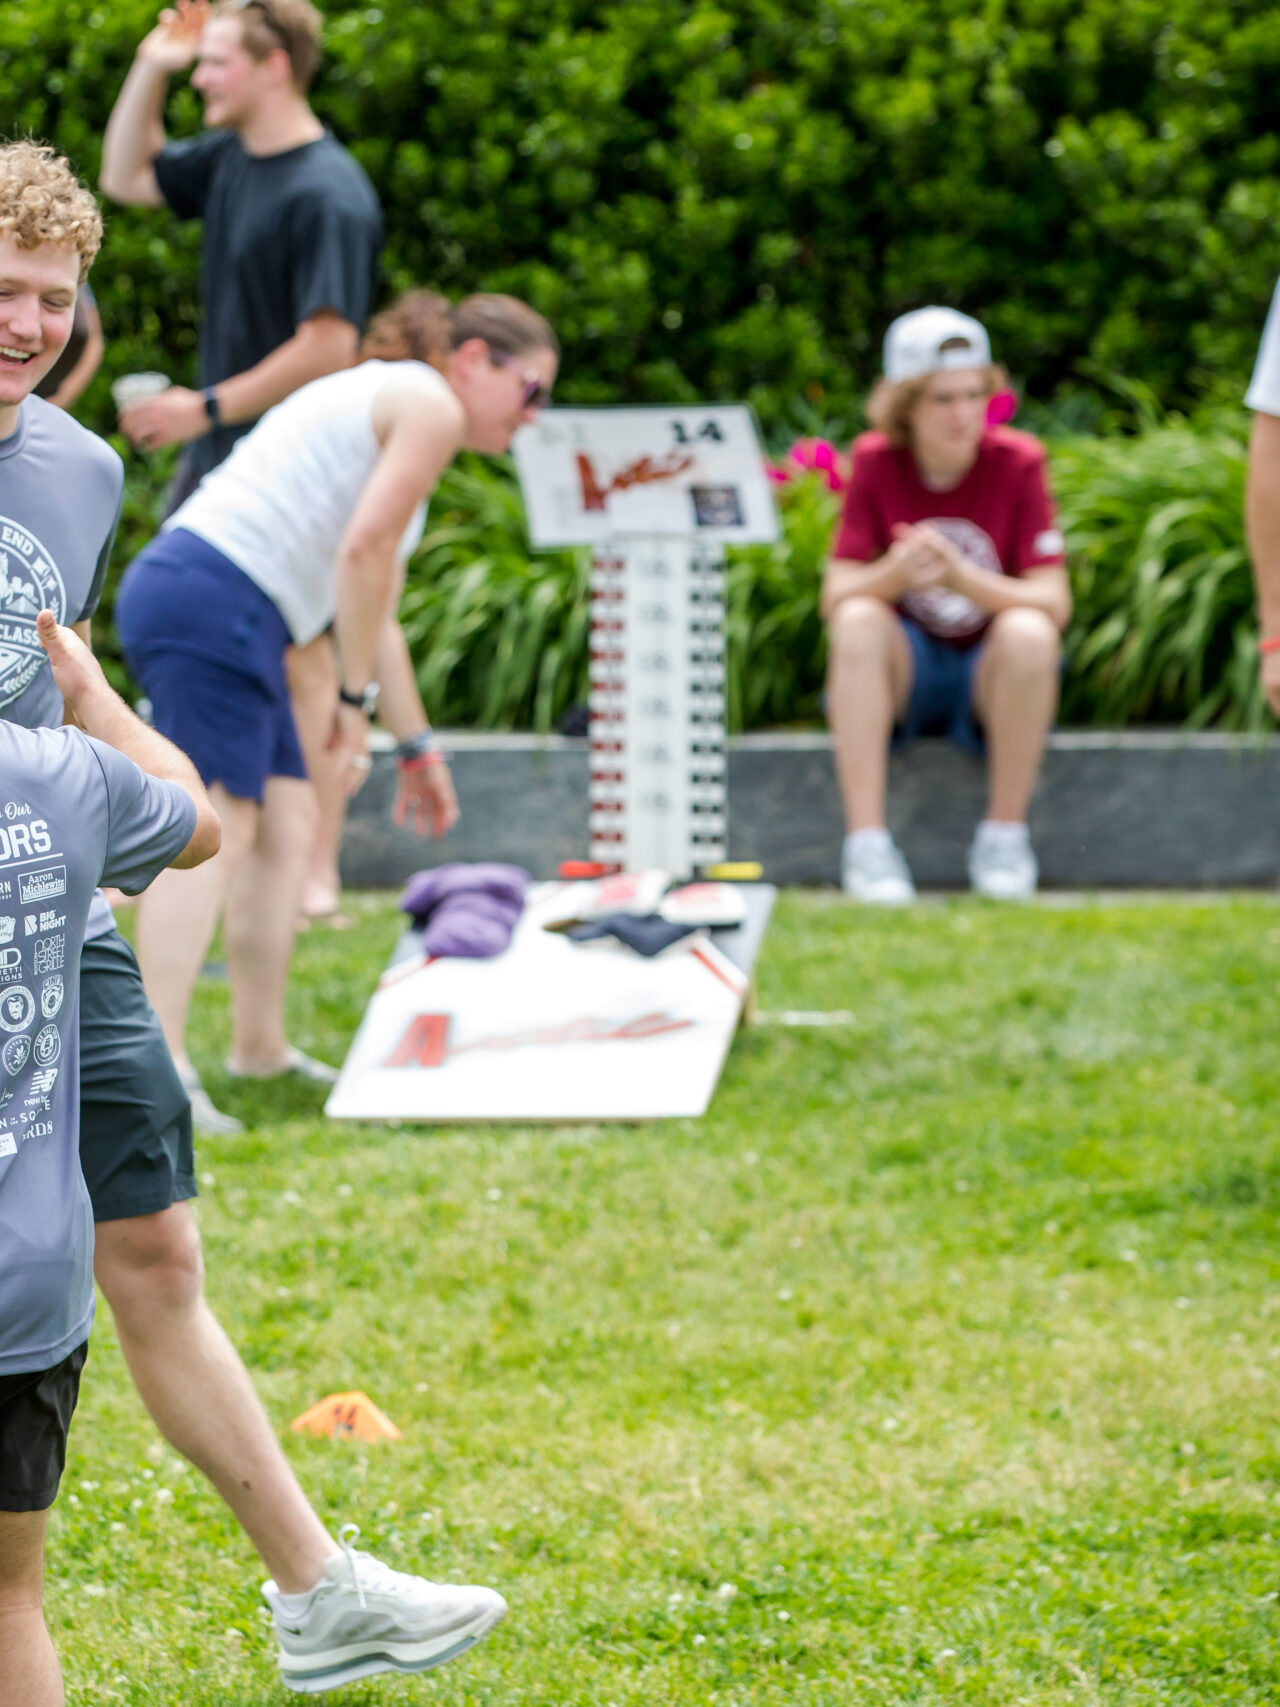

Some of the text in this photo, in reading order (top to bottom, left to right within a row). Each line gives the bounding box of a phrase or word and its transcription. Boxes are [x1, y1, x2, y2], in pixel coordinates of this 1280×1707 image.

[672, 420, 725, 444] 14
[1, 527, 35, 557] END
[5, 801, 33, 820] Our
[28, 872, 54, 885] Aaron
[39, 909, 56, 923] BIG
[39, 915, 67, 933] NIGHT
